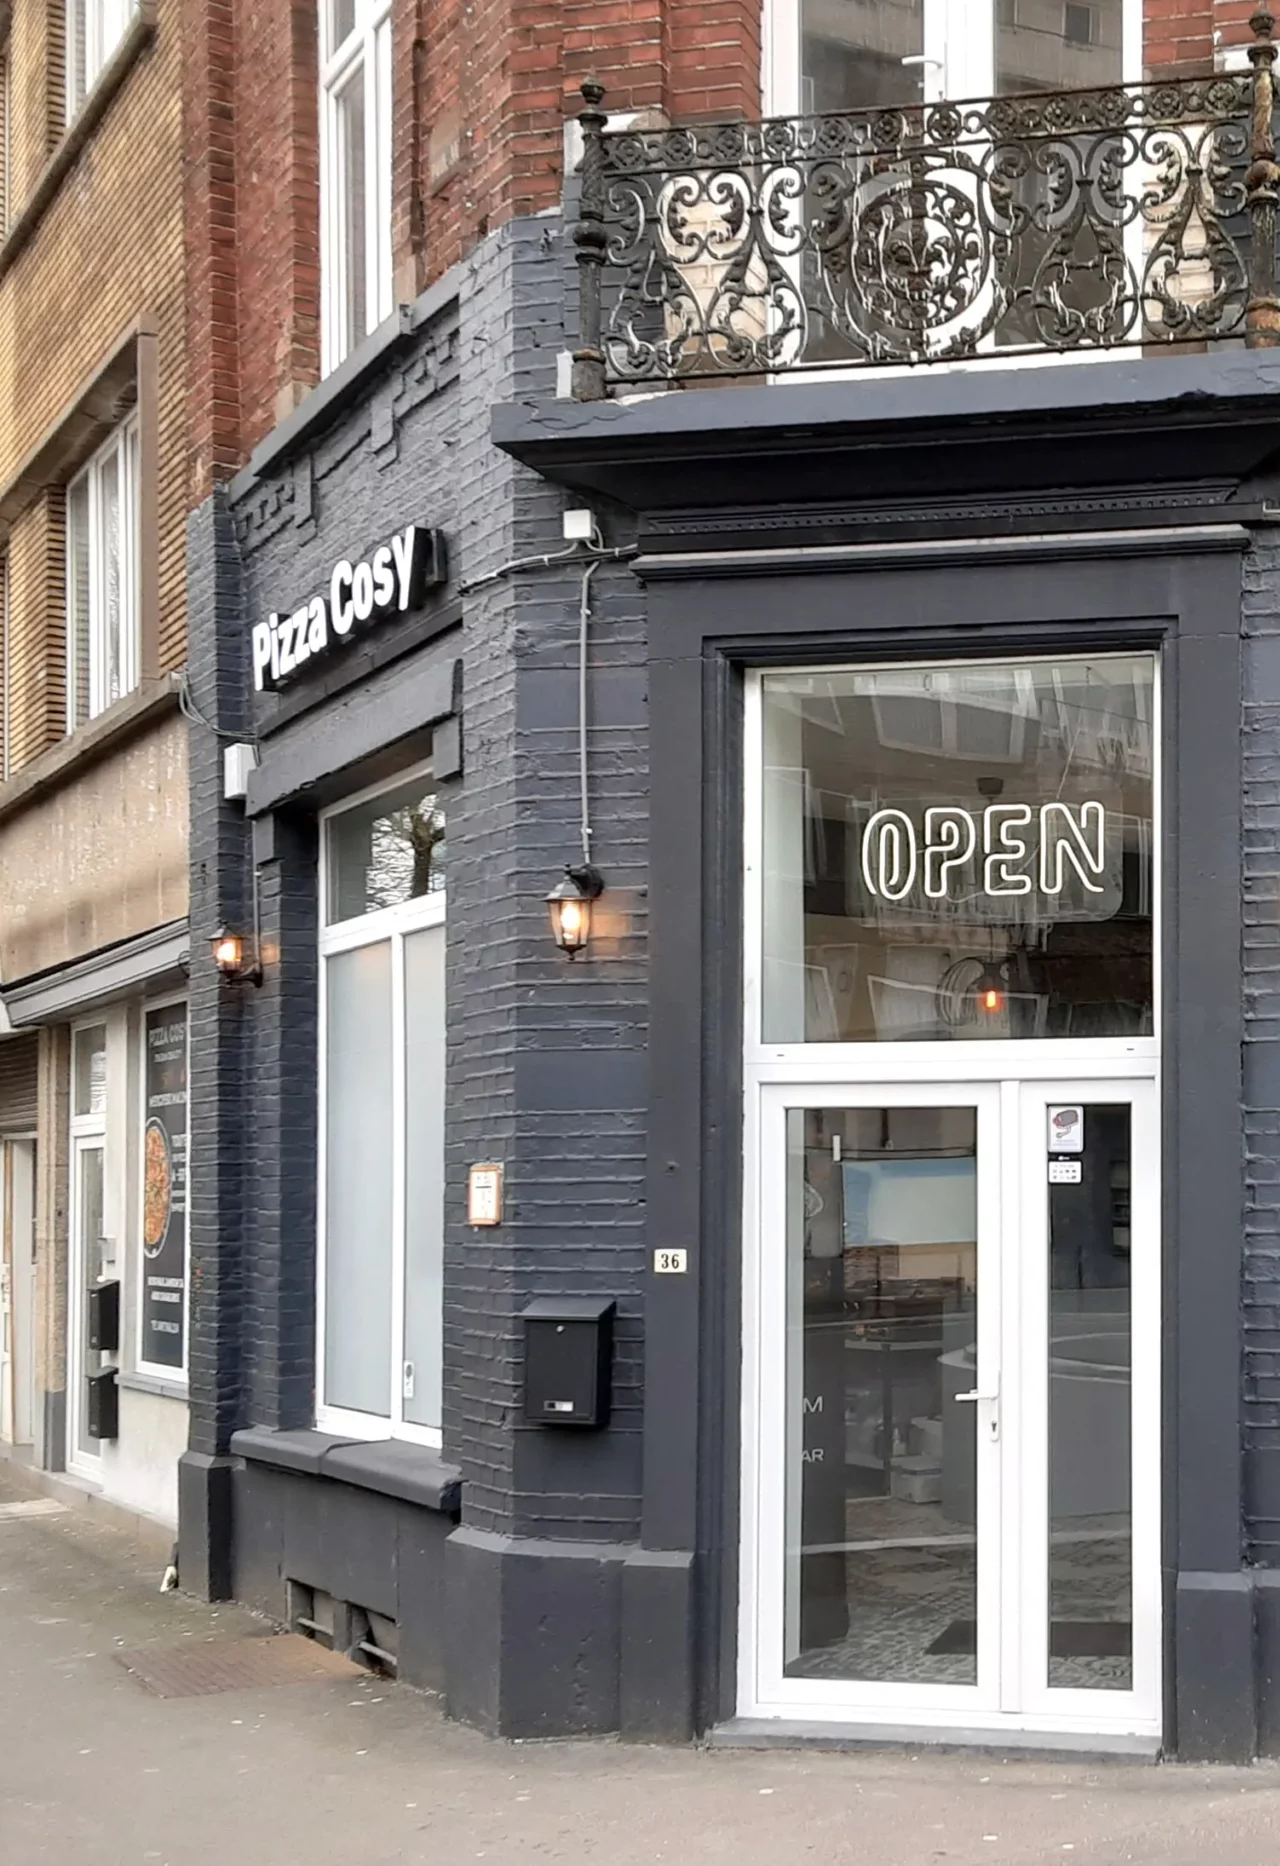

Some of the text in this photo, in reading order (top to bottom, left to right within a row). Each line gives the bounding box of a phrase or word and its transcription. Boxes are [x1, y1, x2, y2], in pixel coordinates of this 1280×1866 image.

[252, 524, 416, 692] Pizza Cosy
[862, 801, 1105, 900] OPEN
[661, 1253, 680, 1269] 36
